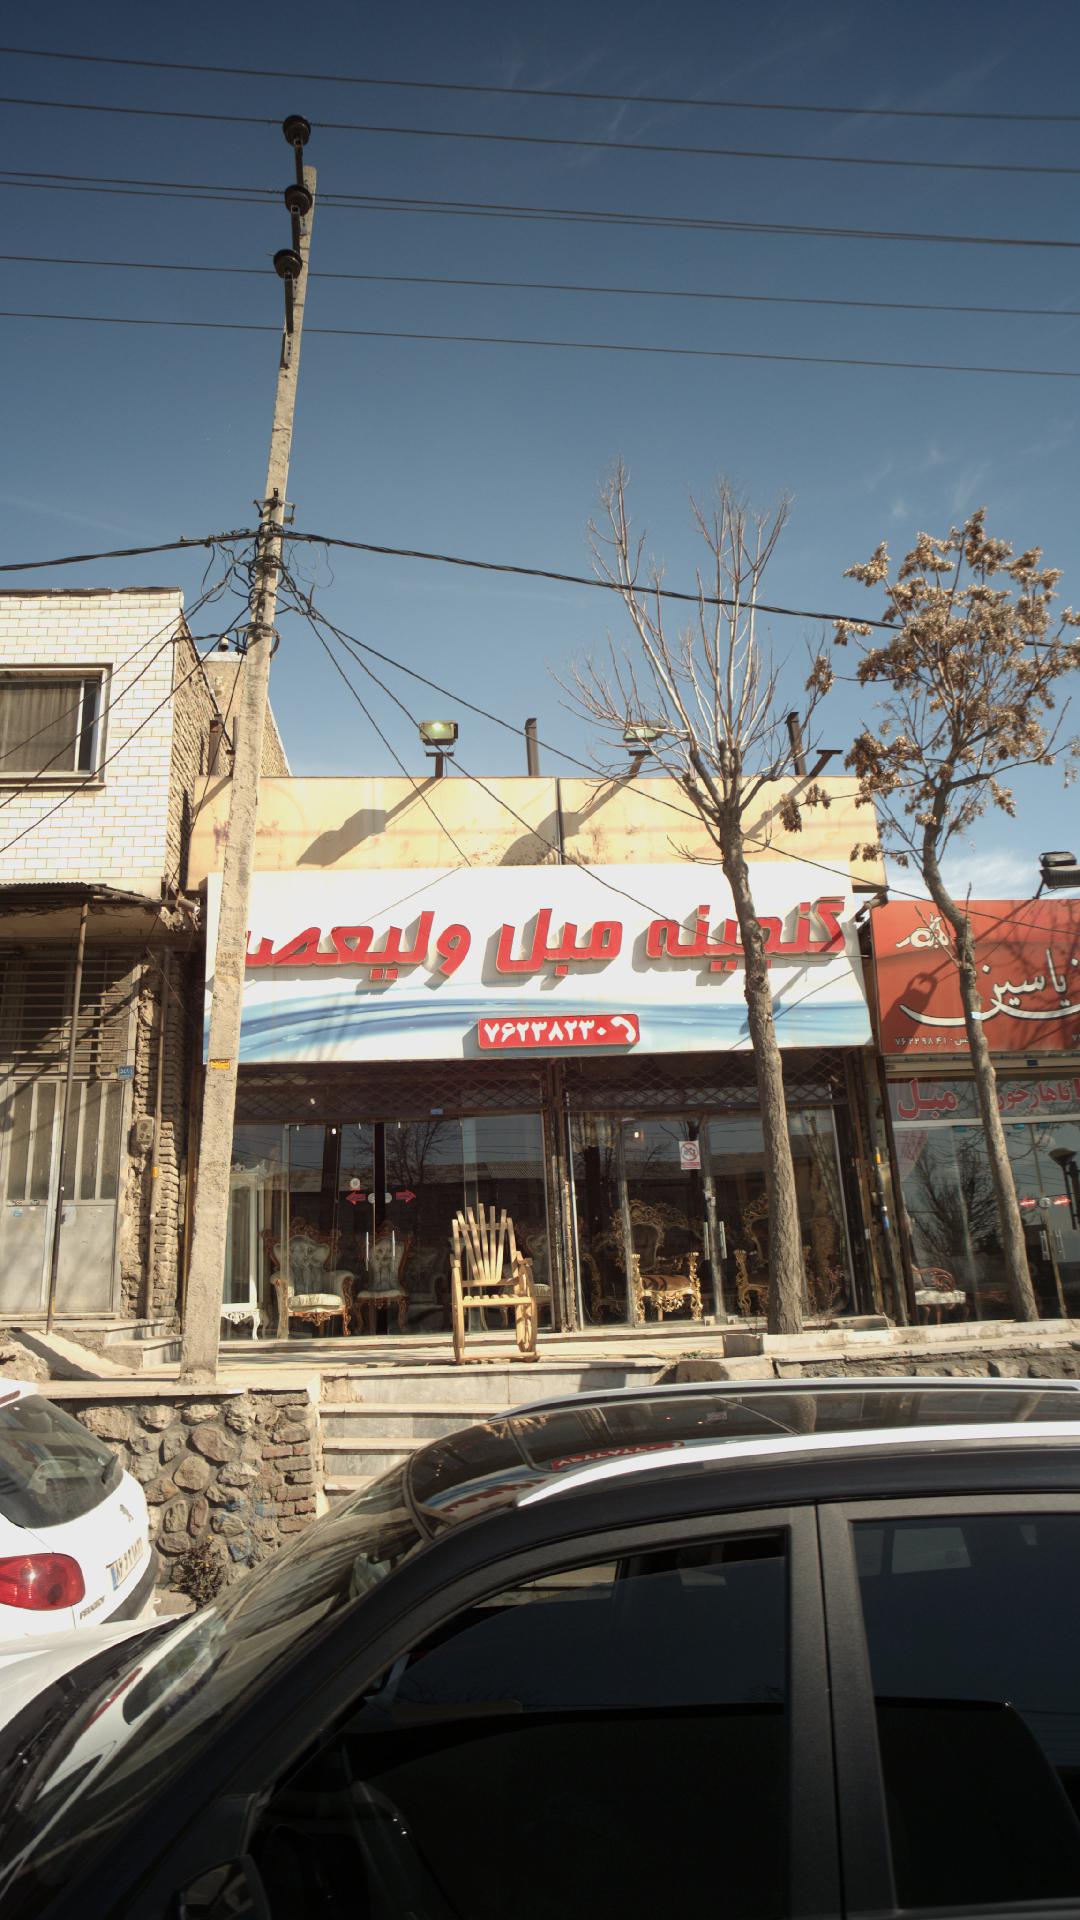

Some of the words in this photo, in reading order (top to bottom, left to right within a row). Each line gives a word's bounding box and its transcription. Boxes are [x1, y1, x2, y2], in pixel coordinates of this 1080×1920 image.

[245, 911, 471, 981] ولیعص
[495, 908, 623, 976] مبل
[484, 1019, 607, 1043] ۷۶۲۳۸۲۳۰
[897, 1077, 958, 1120] مبل
